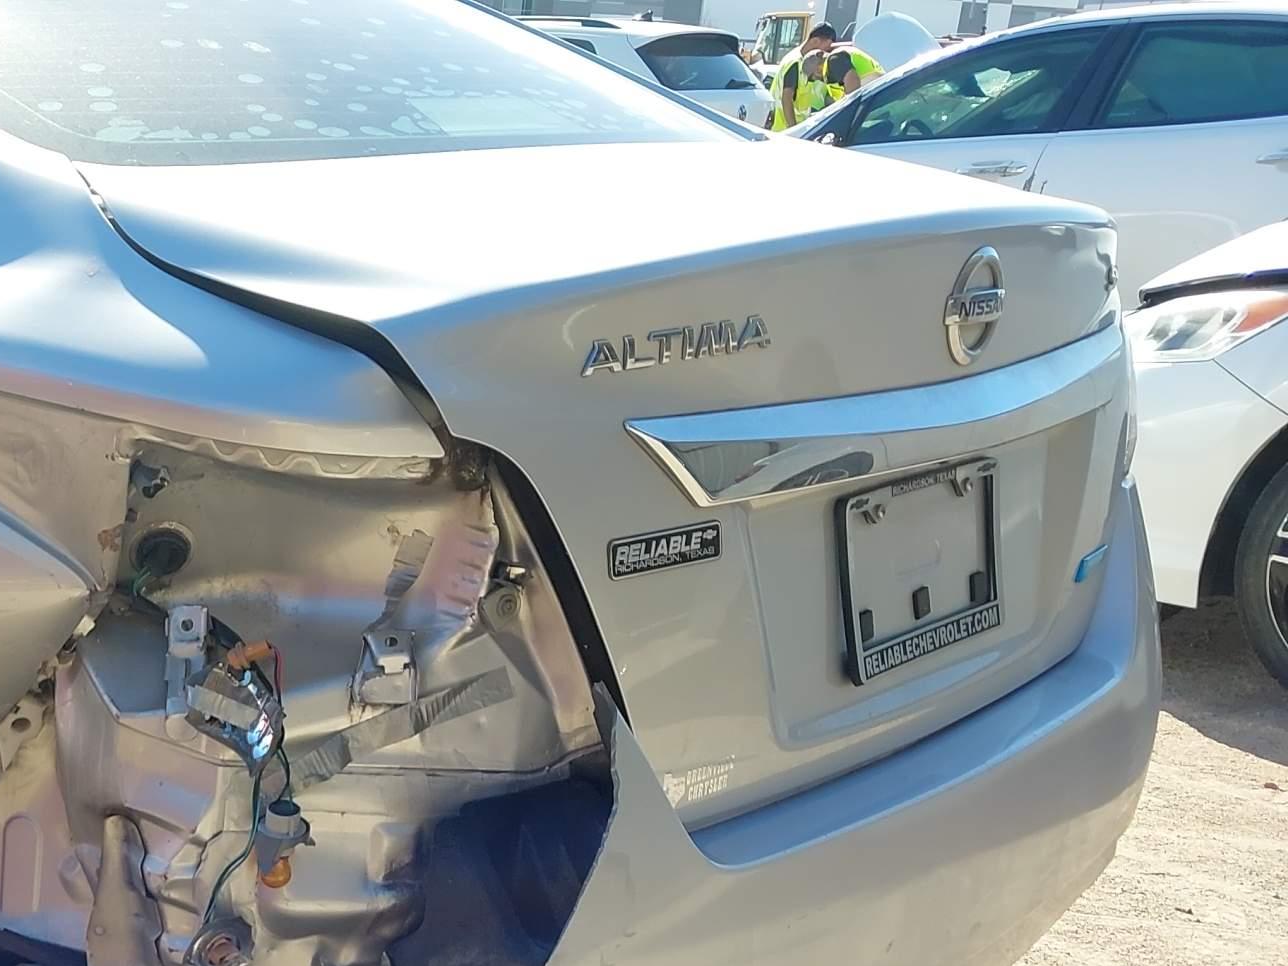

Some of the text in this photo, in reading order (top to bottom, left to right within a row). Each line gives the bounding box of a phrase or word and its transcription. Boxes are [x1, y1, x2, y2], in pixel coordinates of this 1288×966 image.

[958, 299, 1003, 318] NISSAN
[580, 314, 771, 377] ALTIMA
[615, 530, 703, 566] RELIABLE
[615, 546, 715, 575] RICHARDSON, TEXAS
[865, 606, 999, 679] RELIABLECHEVROLET.COM
[687, 774, 728, 801] CHRYSLER
